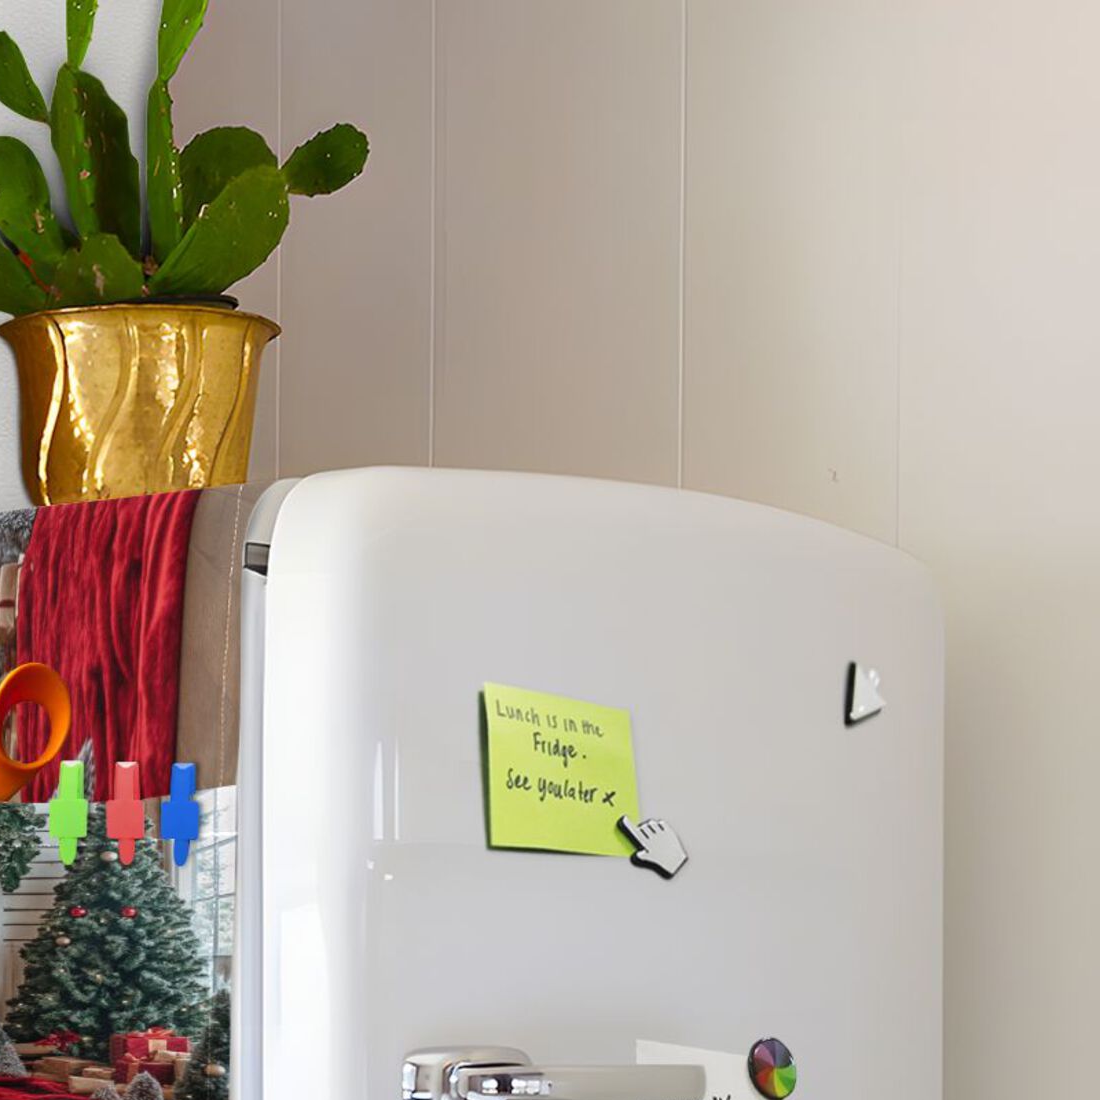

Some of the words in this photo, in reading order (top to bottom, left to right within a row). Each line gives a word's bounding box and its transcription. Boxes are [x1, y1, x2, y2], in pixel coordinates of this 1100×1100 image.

[496, 699, 540, 727] Lunch
[546, 714, 557, 728] is
[564, 718, 578, 733] in
[582, 720, 604, 737] the
[533, 731, 587, 768] Fridge.
[506, 768, 532, 790] See
